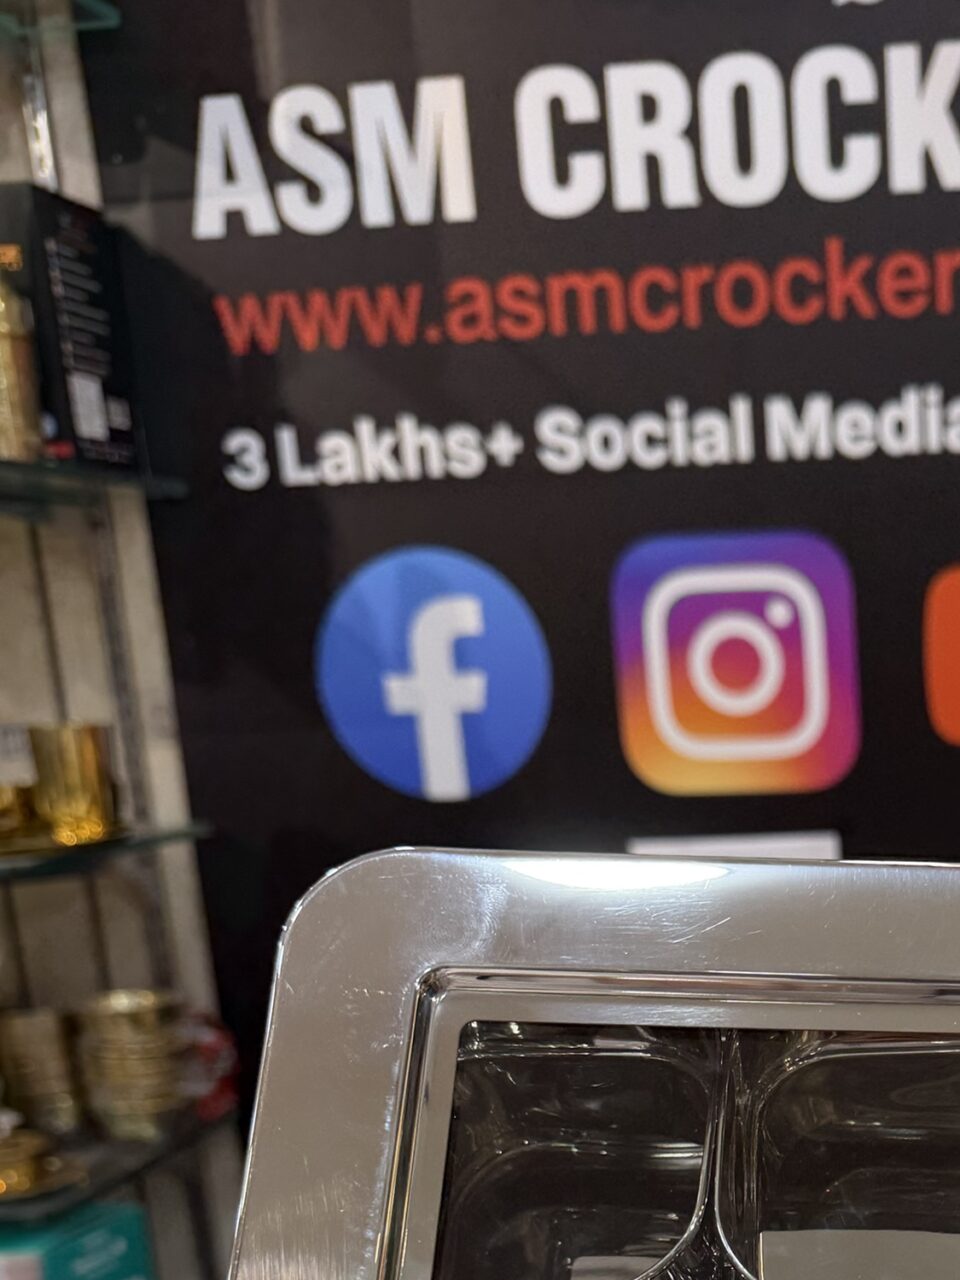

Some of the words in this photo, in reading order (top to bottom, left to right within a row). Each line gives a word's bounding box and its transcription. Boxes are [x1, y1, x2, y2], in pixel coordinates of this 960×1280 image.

[193, 75, 477, 240] ASM
[224, 430, 269, 490] 3
[277, 414, 525, 486] Lakhs+
[534, 395, 755, 474] Social
